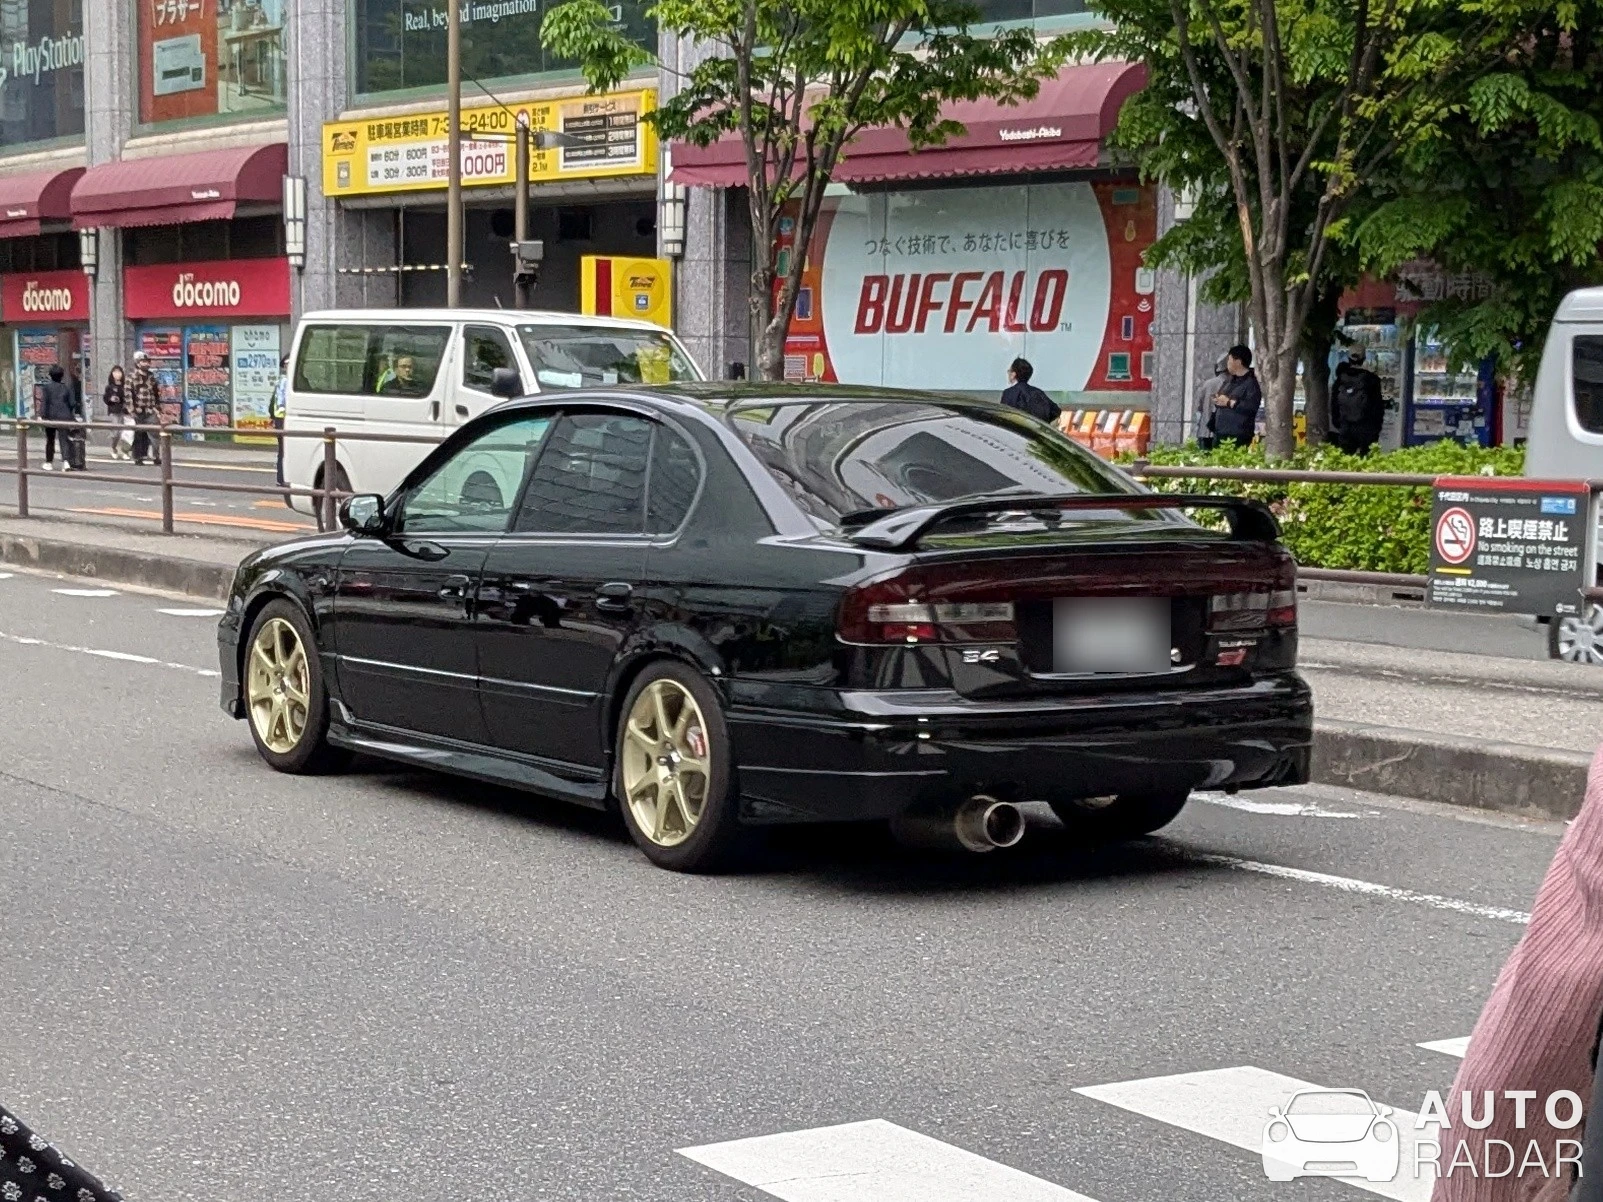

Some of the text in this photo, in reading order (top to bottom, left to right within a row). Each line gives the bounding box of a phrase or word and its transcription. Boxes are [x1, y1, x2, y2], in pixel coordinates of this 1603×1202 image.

[405, 12, 431, 31] Real,
[13, 30, 84, 86] PlayStation
[23, 281, 71, 312] docomo
[173, 273, 240, 307] docomo
[854, 269, 1069, 335] BUFFALO
[1479, 517, 1569, 542] 路上喫煙禁止
[1478, 540, 1578, 557] No smoking on the street
